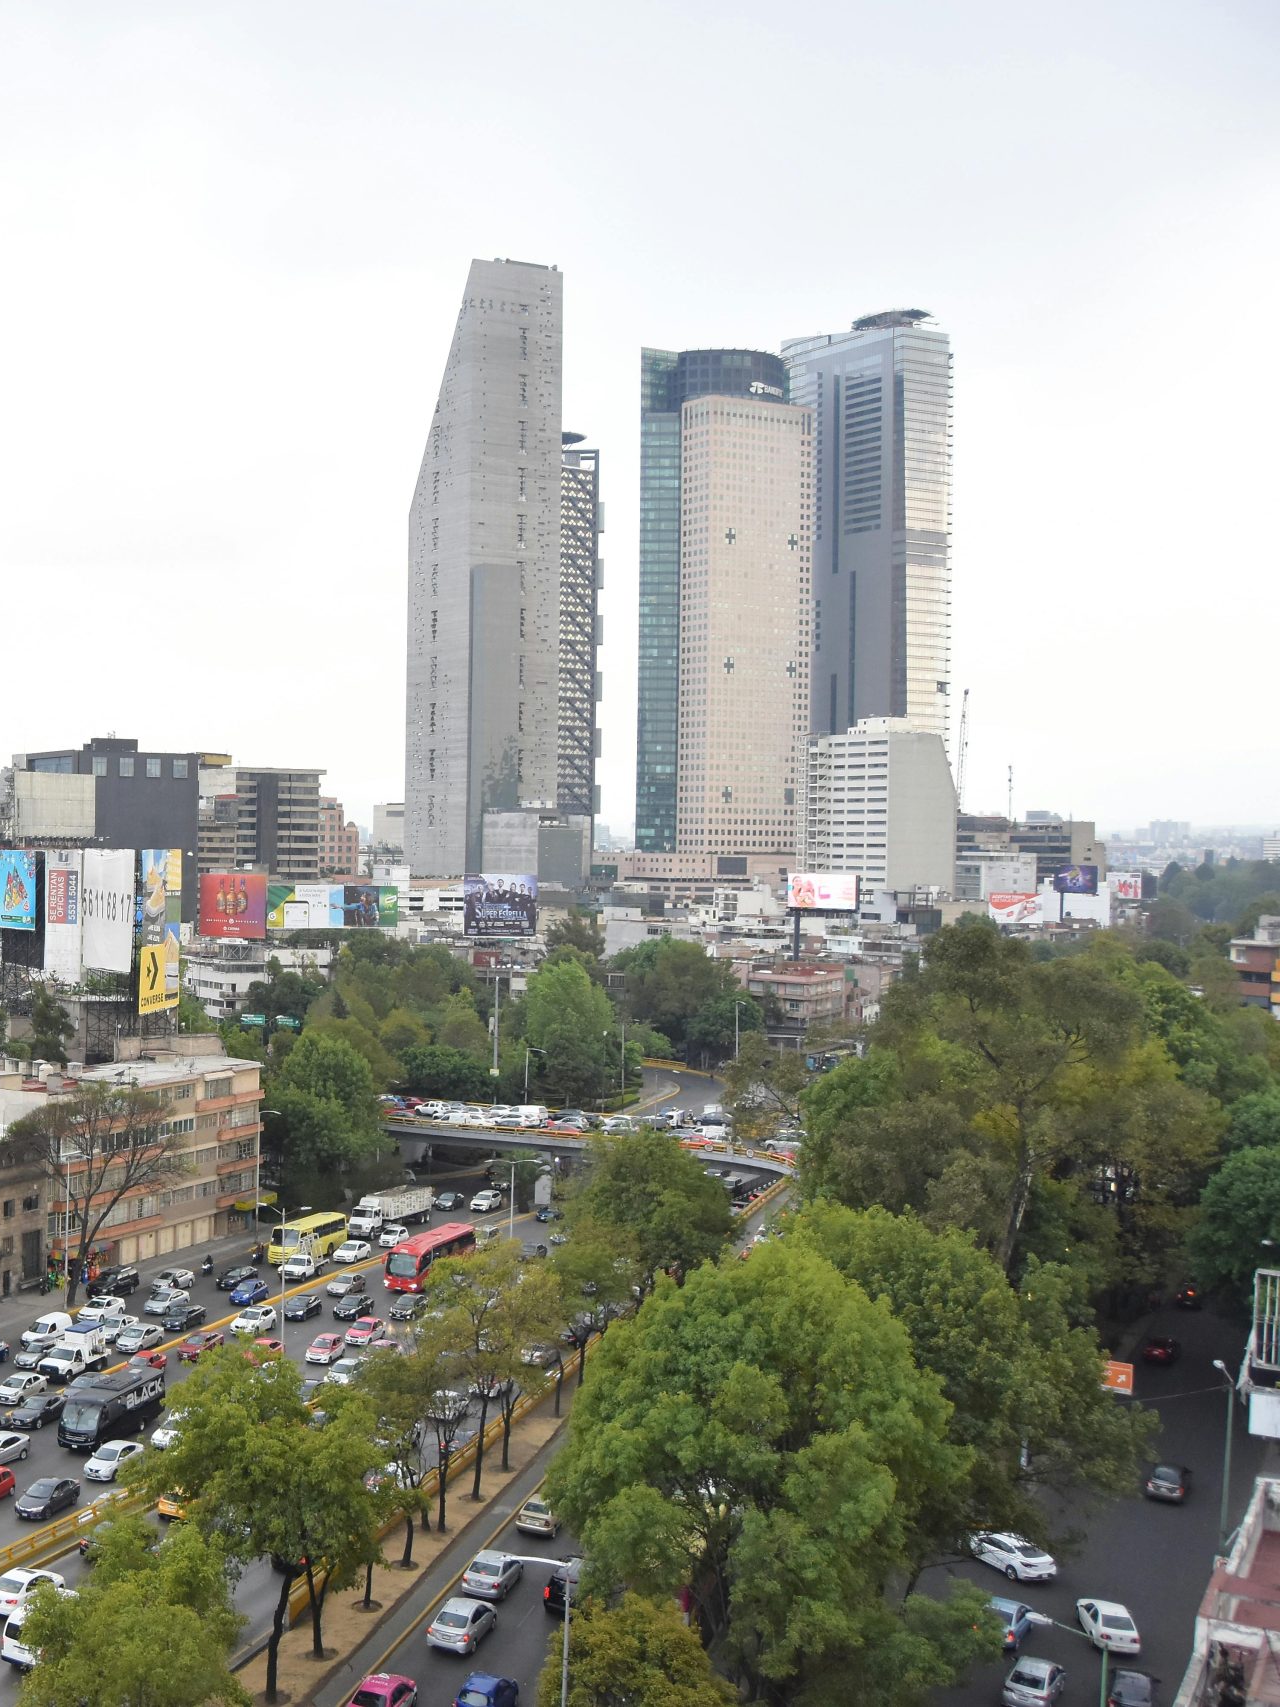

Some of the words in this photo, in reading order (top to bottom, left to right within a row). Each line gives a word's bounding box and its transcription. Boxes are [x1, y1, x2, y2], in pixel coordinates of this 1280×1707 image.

[56, 876, 65, 917] OFICINAS
[68, 875, 77, 920] 5531.5044
[49, 909, 57, 921] SE
[475, 905, 498, 919] SUPER
[498, 908, 528, 919] ESTRELLA
[141, 993, 164, 1007] CONVERSE
[126, 1377, 163, 1410] BLACK
